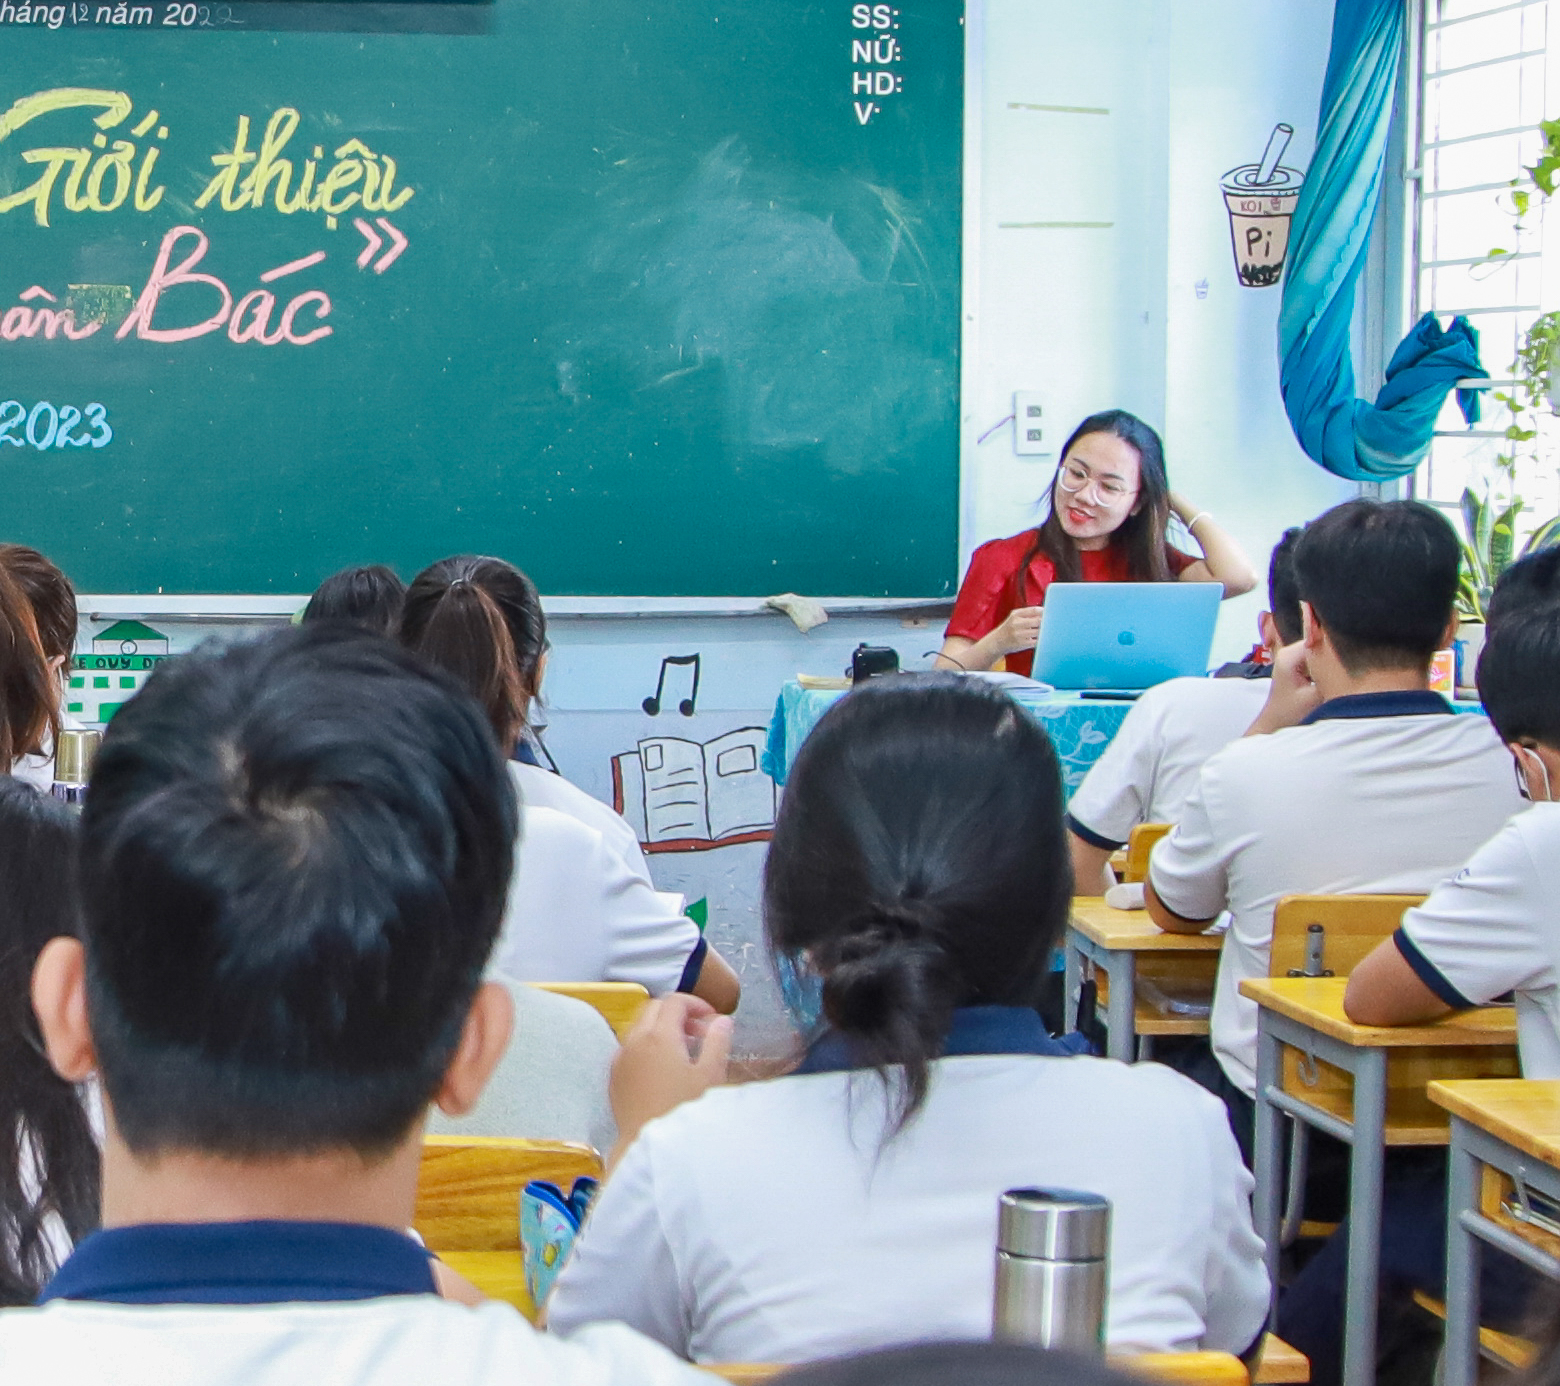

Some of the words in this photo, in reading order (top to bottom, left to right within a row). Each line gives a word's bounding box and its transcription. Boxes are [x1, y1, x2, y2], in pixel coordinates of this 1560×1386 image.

[96, 2, 153, 24] năm
[195, 106, 415, 231] thiệu
[1246, 226, 1272, 258] Pi
